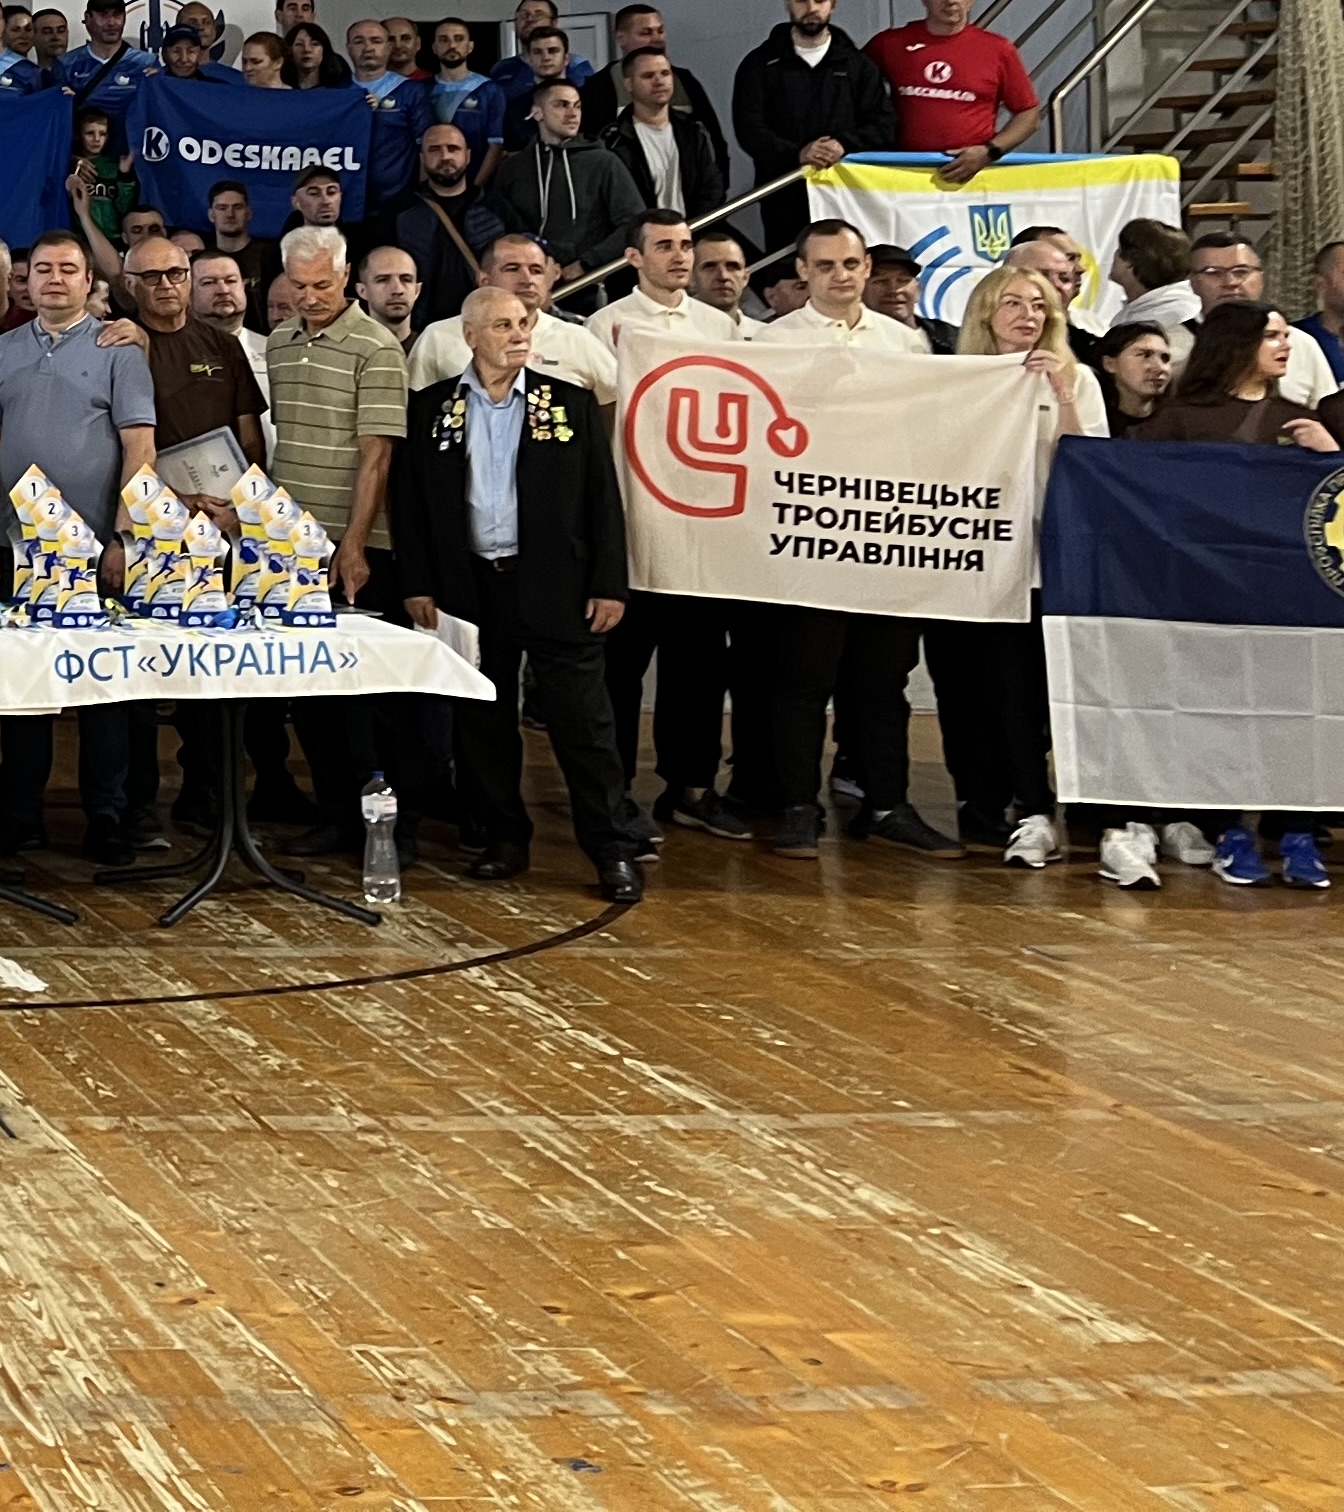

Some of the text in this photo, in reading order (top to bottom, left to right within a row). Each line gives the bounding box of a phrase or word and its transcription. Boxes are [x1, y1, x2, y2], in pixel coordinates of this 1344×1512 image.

[774, 470, 1002, 510] ЧЕРНІВЕЦЬКЕ
[48, 502, 56, 515] 2
[163, 501, 171, 515] 2
[277, 501, 285, 515] 2
[772, 502, 1014, 542] ТРОЛЕЙБУСНЕ
[71, 525, 79, 537] 3
[197, 524, 205, 536] 3
[303, 524, 311, 537] 3
[769, 533, 986, 572] УПРАВЛІННЯ
[53, 636, 359, 684] ФСТ«УКРАЇНА»
